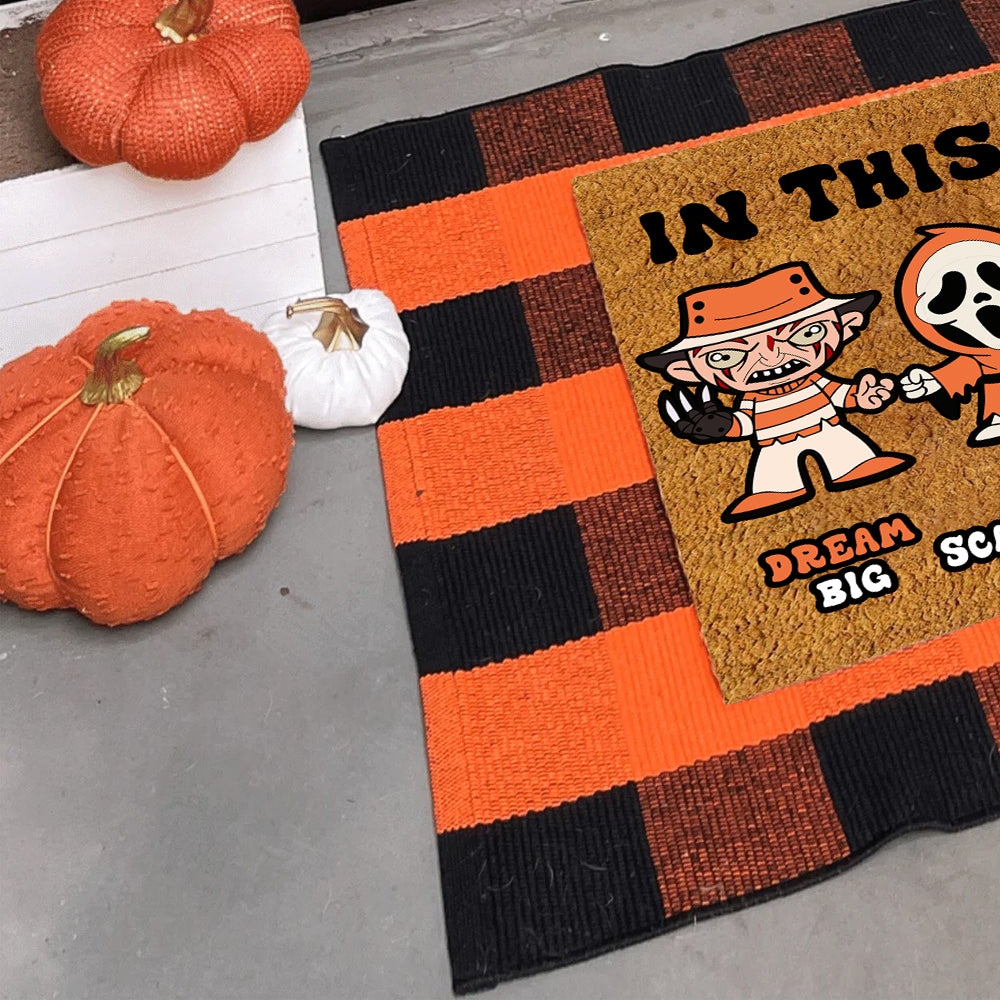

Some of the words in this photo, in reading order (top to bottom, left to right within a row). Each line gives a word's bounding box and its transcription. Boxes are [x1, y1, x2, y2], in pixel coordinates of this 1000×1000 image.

[638, 189, 759, 265] IN
[764, 517, 916, 584] DREAM
[815, 563, 893, 609] BIG
